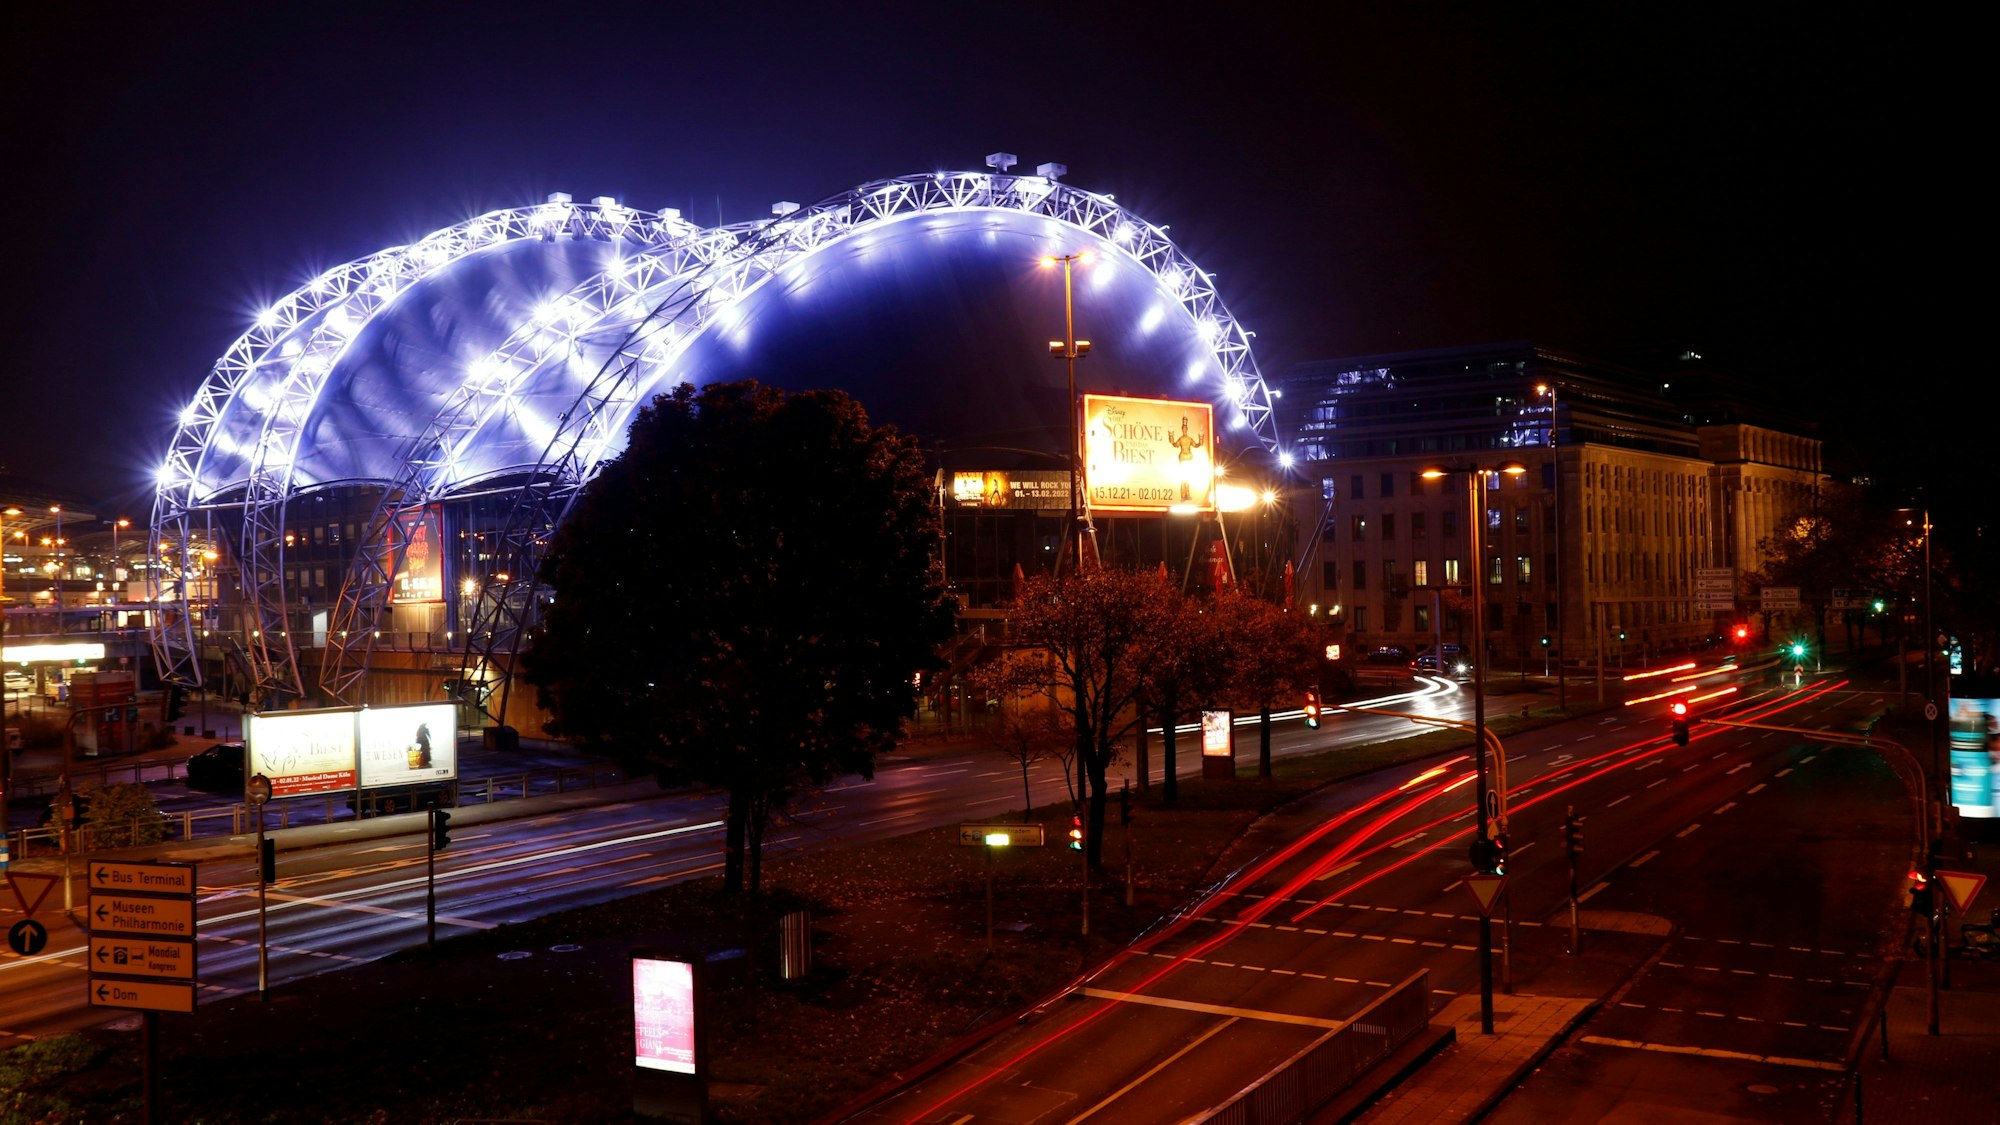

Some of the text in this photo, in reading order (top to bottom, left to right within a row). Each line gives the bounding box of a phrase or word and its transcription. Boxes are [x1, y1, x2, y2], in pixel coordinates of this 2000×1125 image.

[1105, 405, 1126, 417] Disney
[1102, 416, 1163, 442] SCHÖNE
[1113, 441, 1155, 464] BIEST
[1010, 481, 1021, 489] WE
[1023, 481, 1039, 489] WILL
[1040, 481, 1058, 489] ROCK
[1015, 490, 1025, 498] 01.
[1095, 487, 1130, 499] 15.12.21
[1138, 488, 1173, 501] 02.01.22
[374, 750, 404, 761] WESEN
[302, 774, 322, 782] Musical
[112, 870, 185, 886] Bus Terminal
[112, 901, 155, 914] Museen
[112, 916, 185, 931] Philharmonie
[148, 945, 180, 959] Mondial
[148, 961, 177, 972] Kongress
[113, 987, 138, 1001] Dom
[640, 1038, 663, 1050] GIANT
